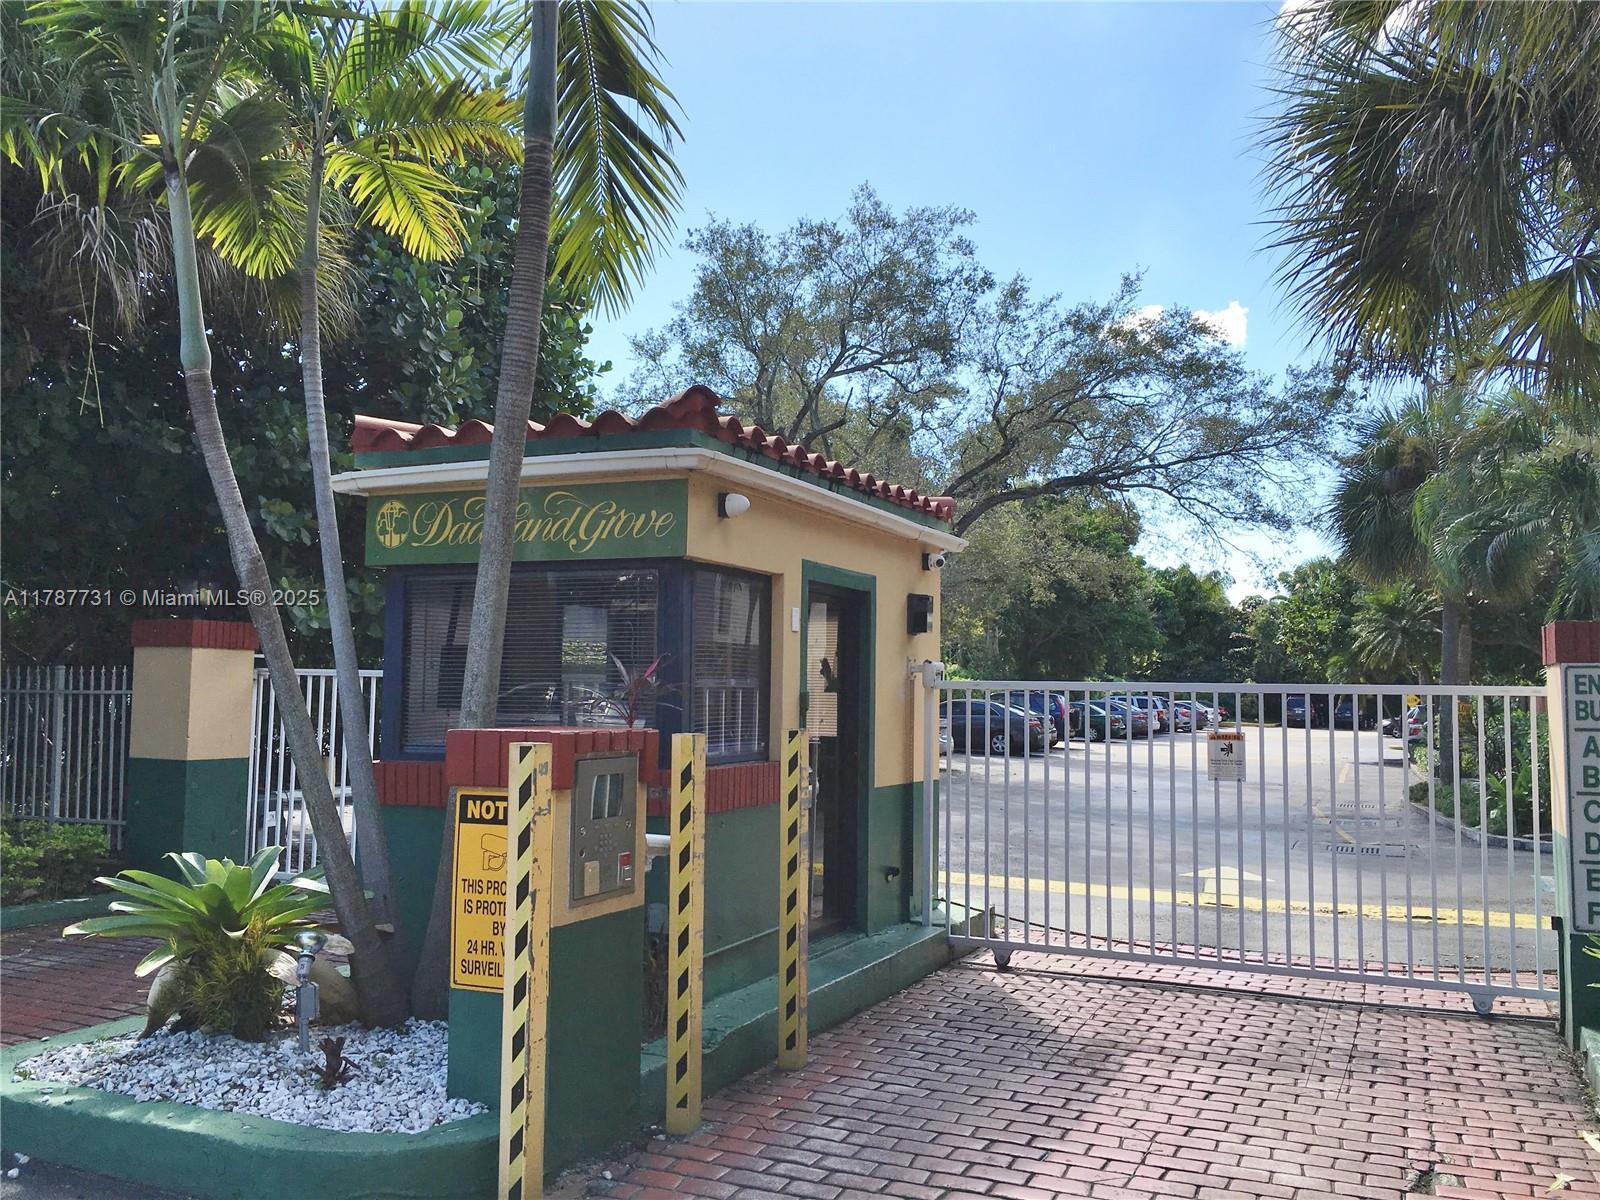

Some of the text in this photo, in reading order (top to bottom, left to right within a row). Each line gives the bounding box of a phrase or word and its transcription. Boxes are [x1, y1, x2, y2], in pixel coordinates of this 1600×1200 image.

[411, 491, 677, 553] Dadand Grove
[1574, 674, 1600, 695] EN
[1582, 735, 1600, 758] A
[1582, 765, 1600, 788] B
[466, 799, 509, 820] NOT
[1583, 799, 1600, 823] C
[1584, 832, 1600, 855] D
[461, 878, 484, 895] THIS
[1586, 868, 1600, 892] E
[463, 899, 473, 914] IS
[1587, 902, 1600, 925] F
[492, 921, 506, 936] BY
[467, 939, 478, 954] 24
[480, 941, 498, 956] HR.
[460, 959, 505, 977] SURVEIL
